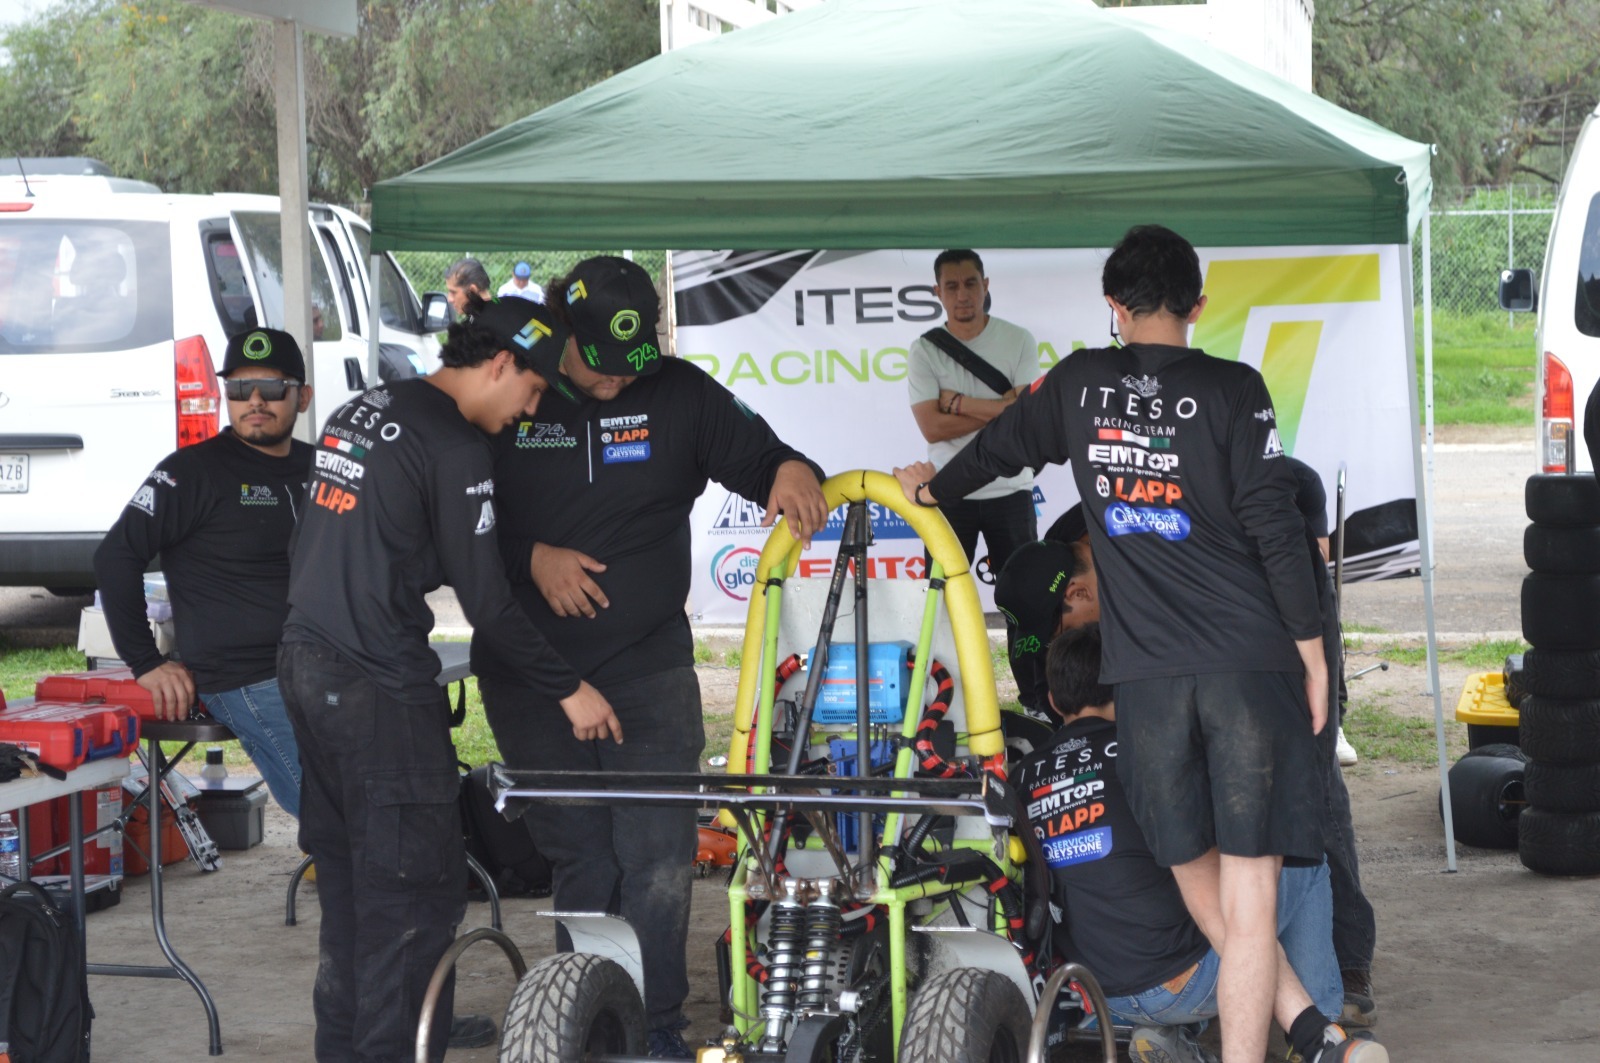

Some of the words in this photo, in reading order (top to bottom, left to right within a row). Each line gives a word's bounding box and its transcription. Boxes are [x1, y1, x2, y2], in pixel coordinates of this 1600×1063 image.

[795, 285, 991, 326] ITES
[627, 343, 658, 372] 74
[1080, 386, 1197, 419] ITESO
[535, 423, 566, 437] 74
[600, 414, 648, 428] EMTOP
[1094, 416, 1140, 434] RACING
[1144, 425, 1176, 437] TEAM
[325, 425, 353, 441] RACING
[352, 433, 374, 450] TEAM
[614, 428, 649, 443] LAPP
[315, 449, 364, 480] EMTOP
[1088, 444, 1179, 472] EMTOP
[251, 486, 272, 497] 74
[1115, 477, 1182, 505] LAPP
[1122, 513, 1180, 531] KEYTONE
[724, 568, 758, 589] glo
[1015, 635, 1040, 659] 74
[1029, 772, 1066, 791] RACING
[1072, 762, 1103, 777] TEAM
[1027, 780, 1105, 820] EMTOP
[1047, 803, 1105, 838] LAPP
[1050, 840, 1102, 859] KEYSTONE
